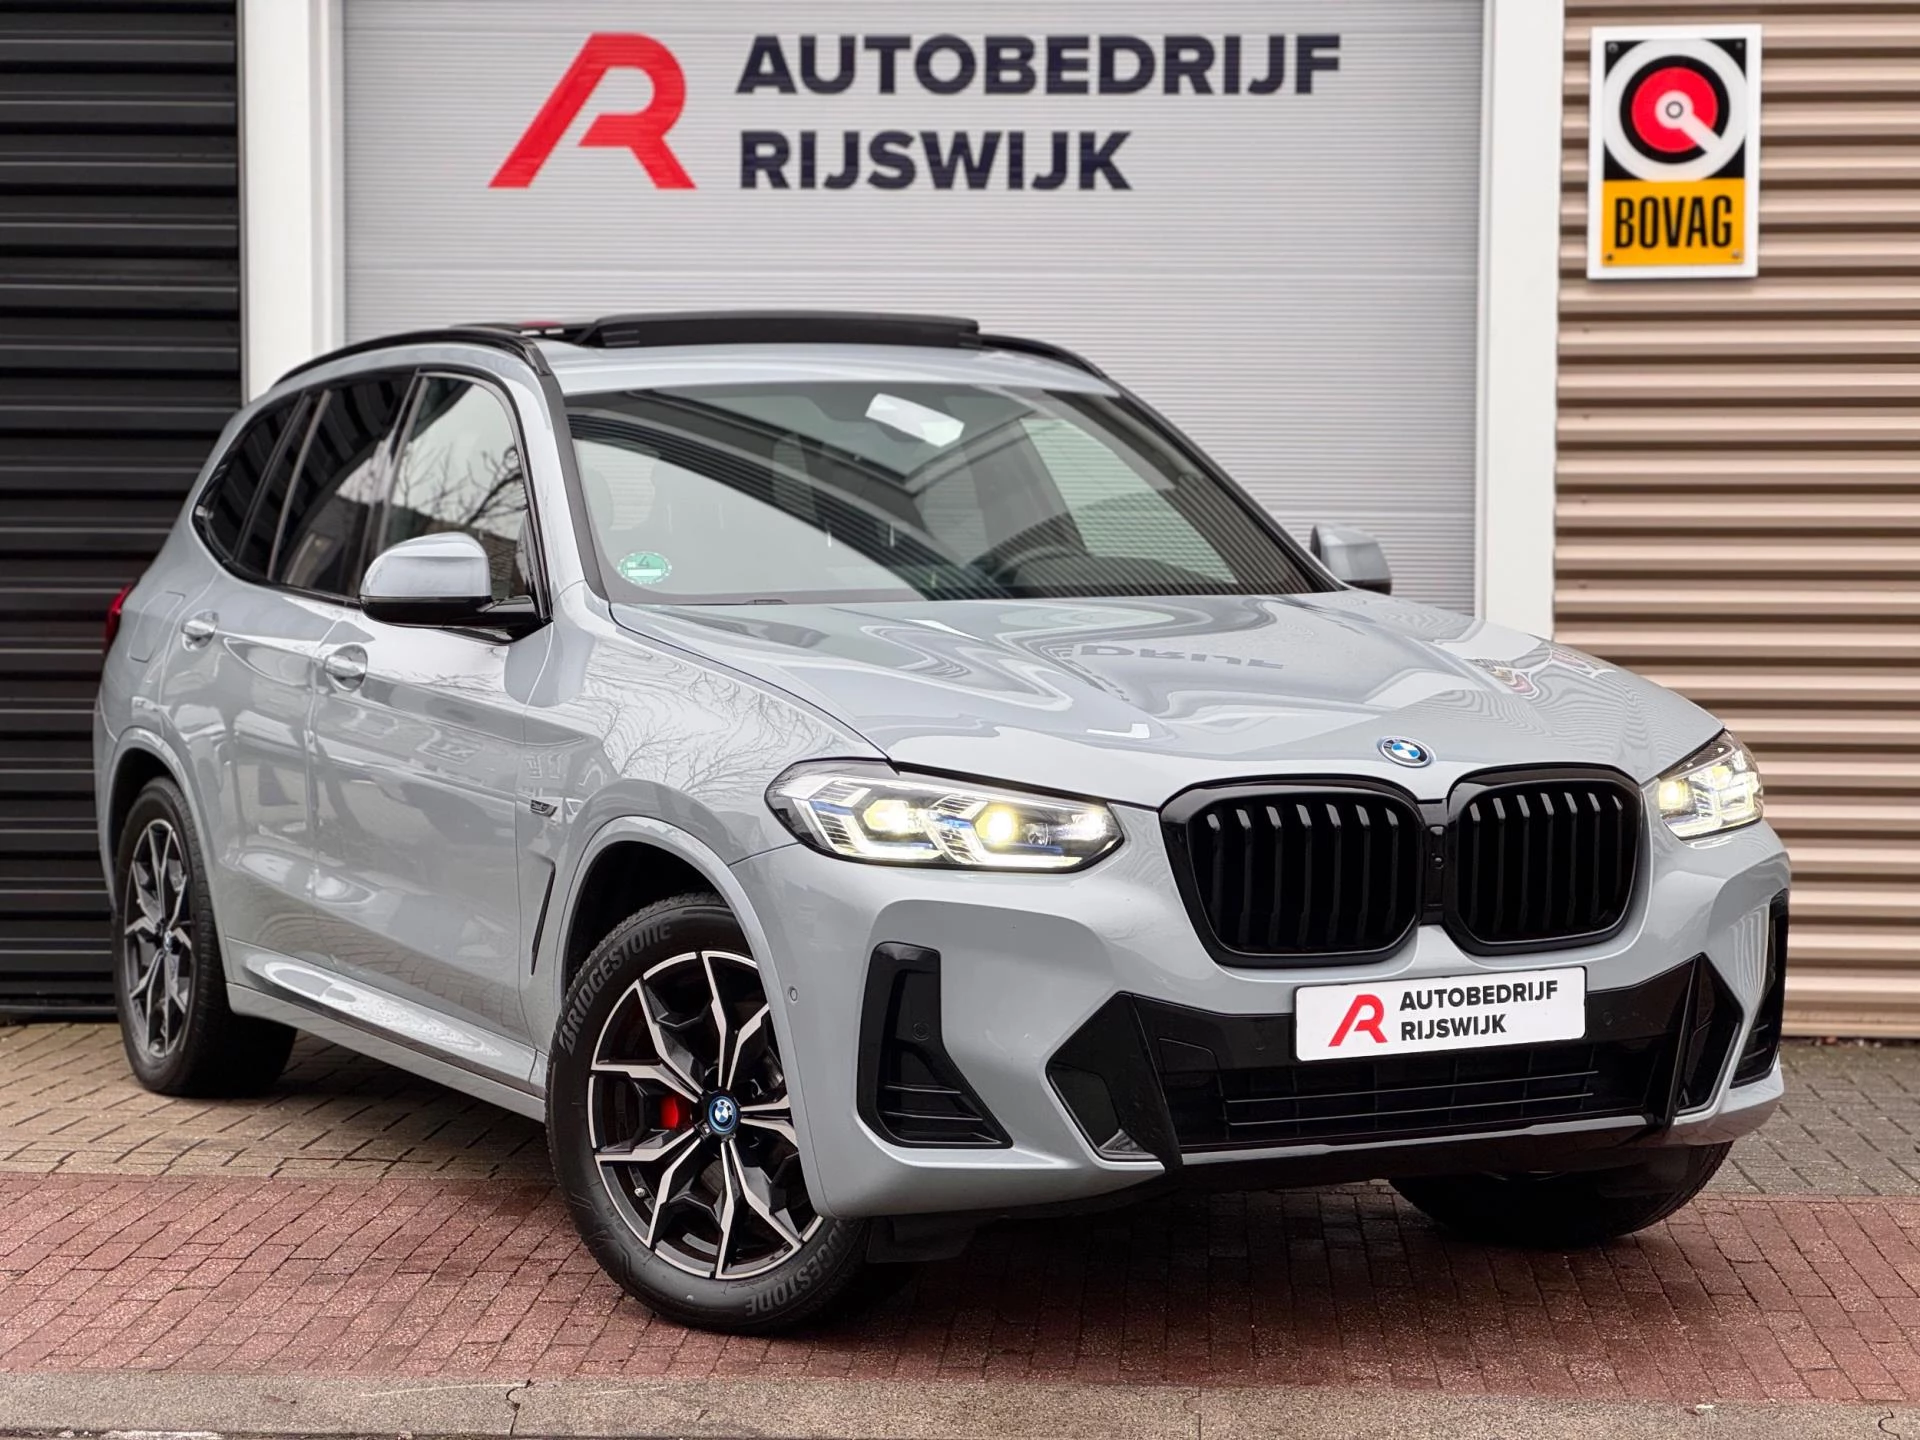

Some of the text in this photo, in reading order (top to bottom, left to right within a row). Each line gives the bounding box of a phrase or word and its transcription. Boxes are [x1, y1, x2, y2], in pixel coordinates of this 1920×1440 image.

[736, 34, 1341, 96] AUTOBEDRIJF
[740, 131, 1132, 190] RIJSWIJK
[1614, 195, 1733, 249] BOVAG
[638, 555, 650, 568] 4
[559, 917, 672, 1056] BRIDGESTONE
[1399, 980, 1558, 1011] AUTOBEDRIJF
[1400, 1014, 1507, 1041] RIJSWIJK
